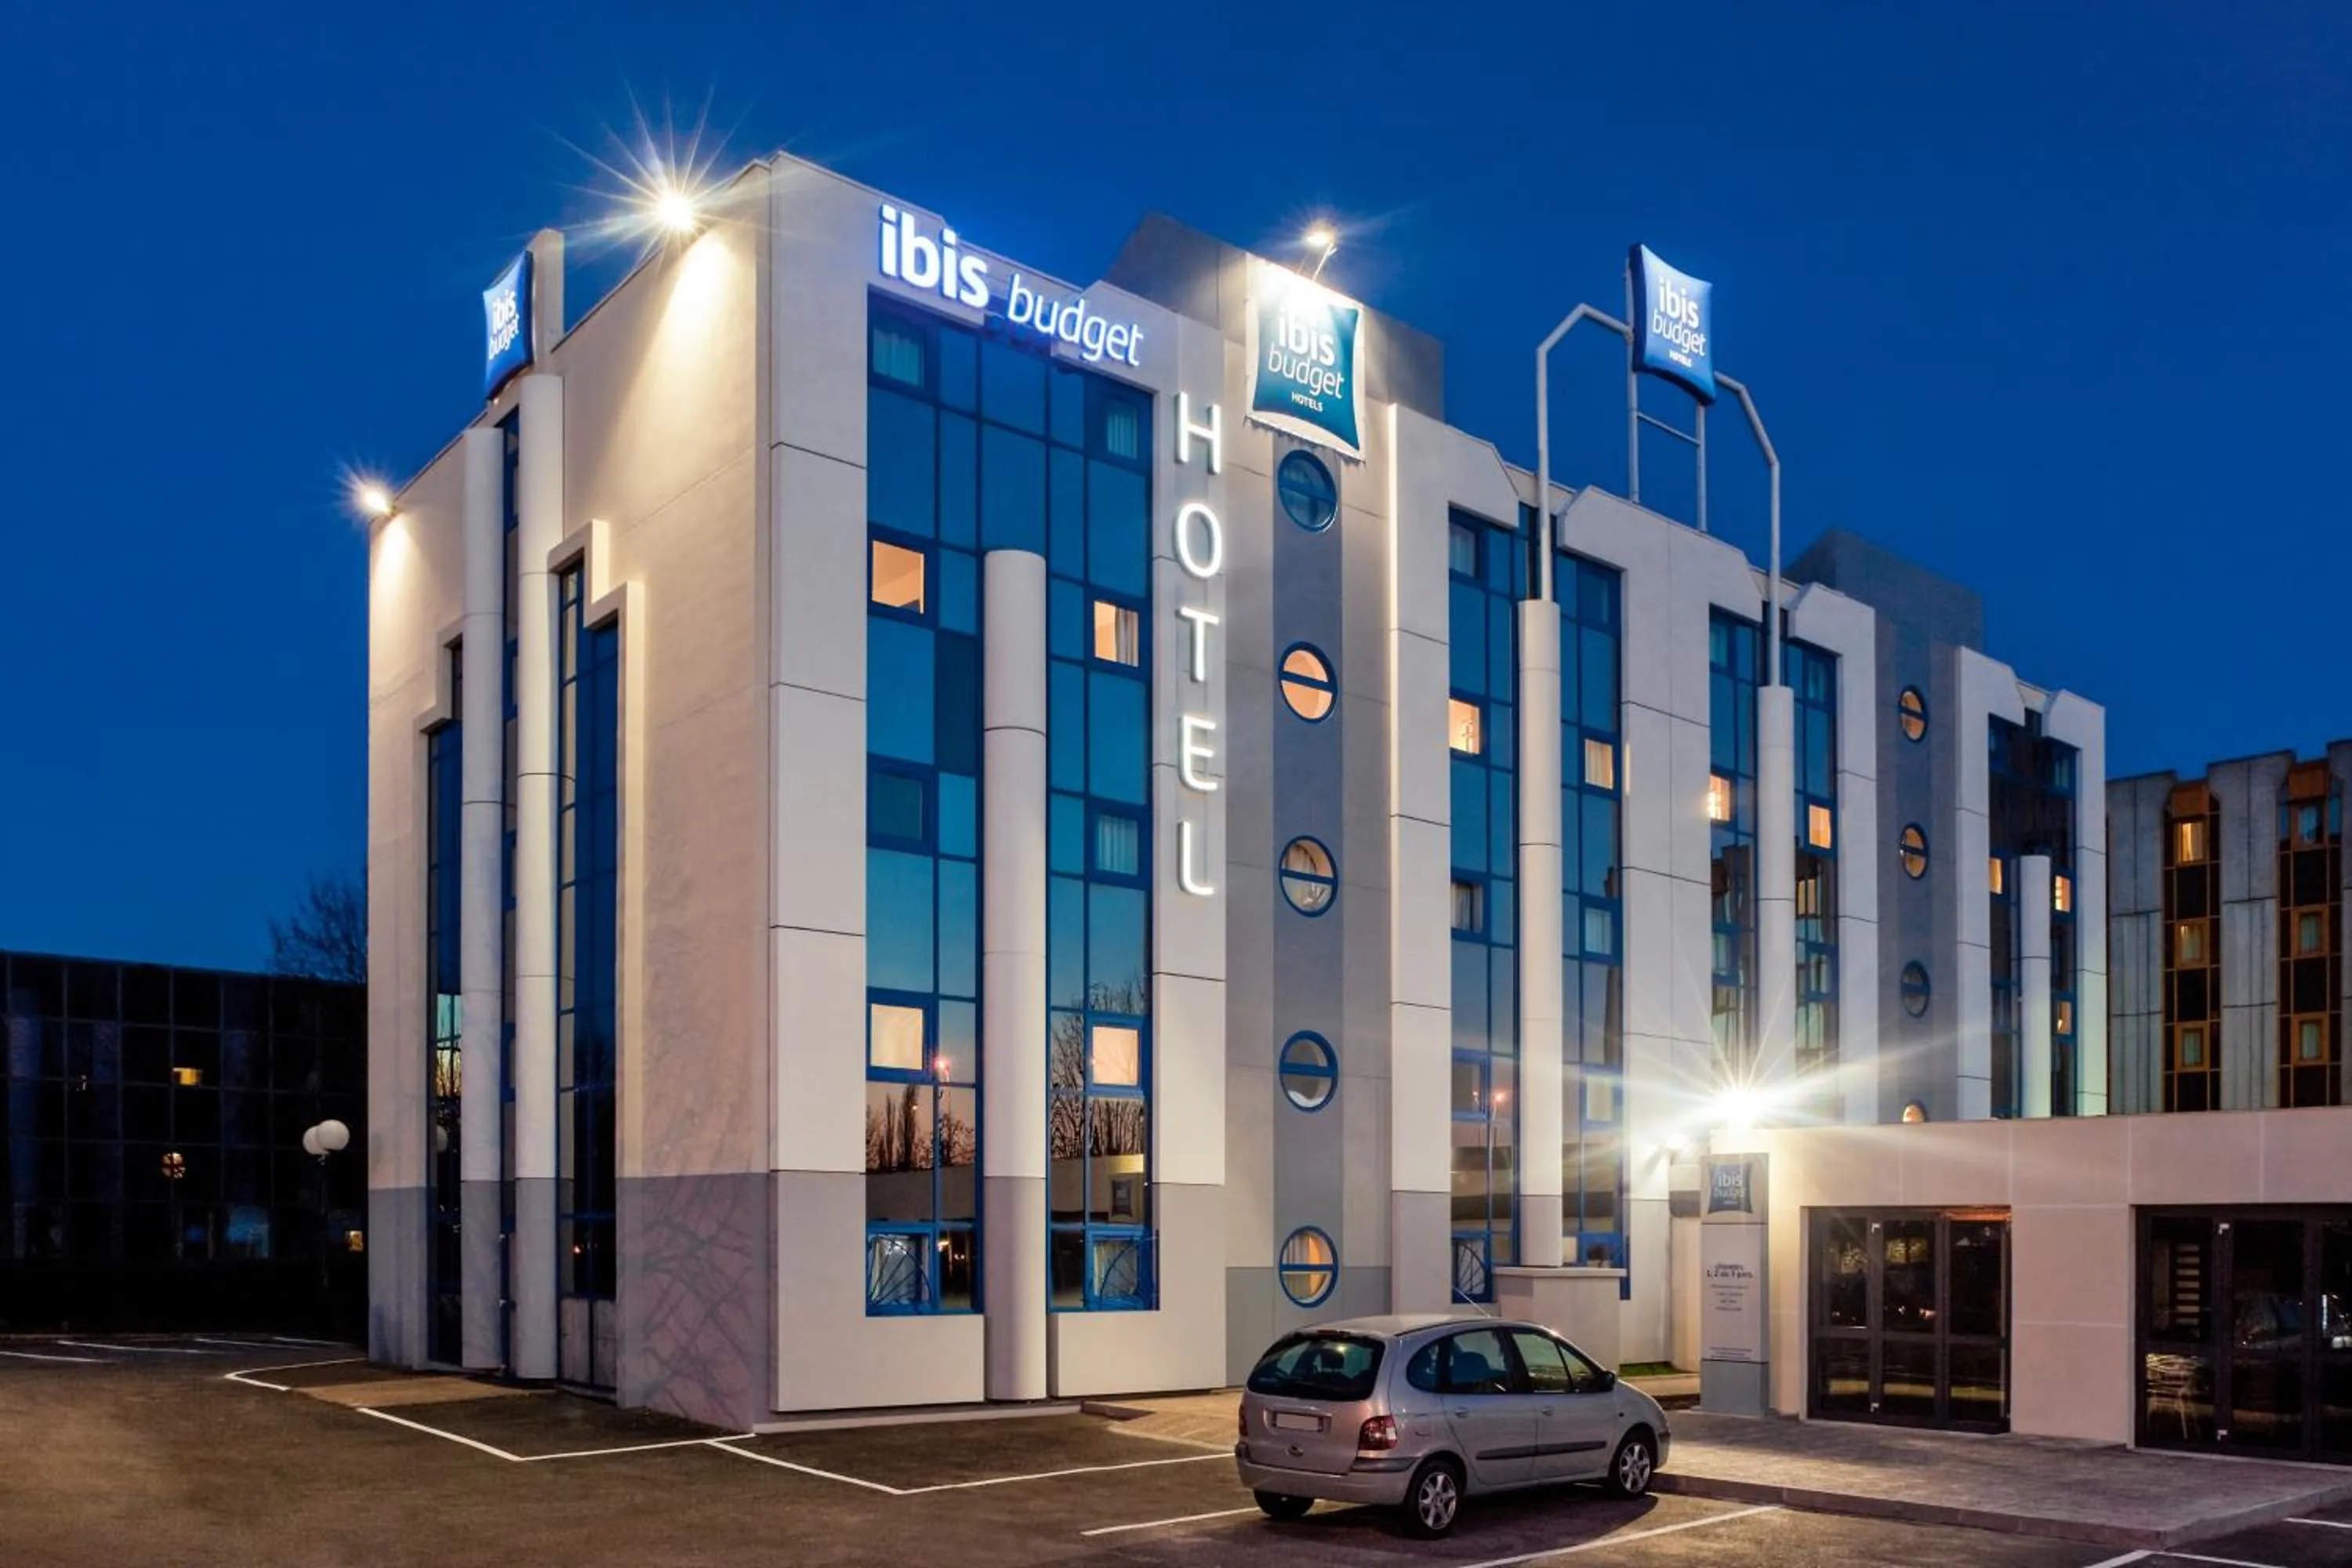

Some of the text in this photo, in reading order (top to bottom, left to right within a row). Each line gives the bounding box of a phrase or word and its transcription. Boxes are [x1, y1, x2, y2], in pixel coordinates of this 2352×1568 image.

[880, 203, 1144, 366] ibis budget
[1658, 277, 1700, 328] ibis
[1278, 298, 1336, 366] ibis
[1652, 308, 1707, 356] budget
[1268, 343, 1345, 399] budget
[1291, 391, 1324, 412] HOTELS
[1176, 392, 1222, 897] HOTEL
